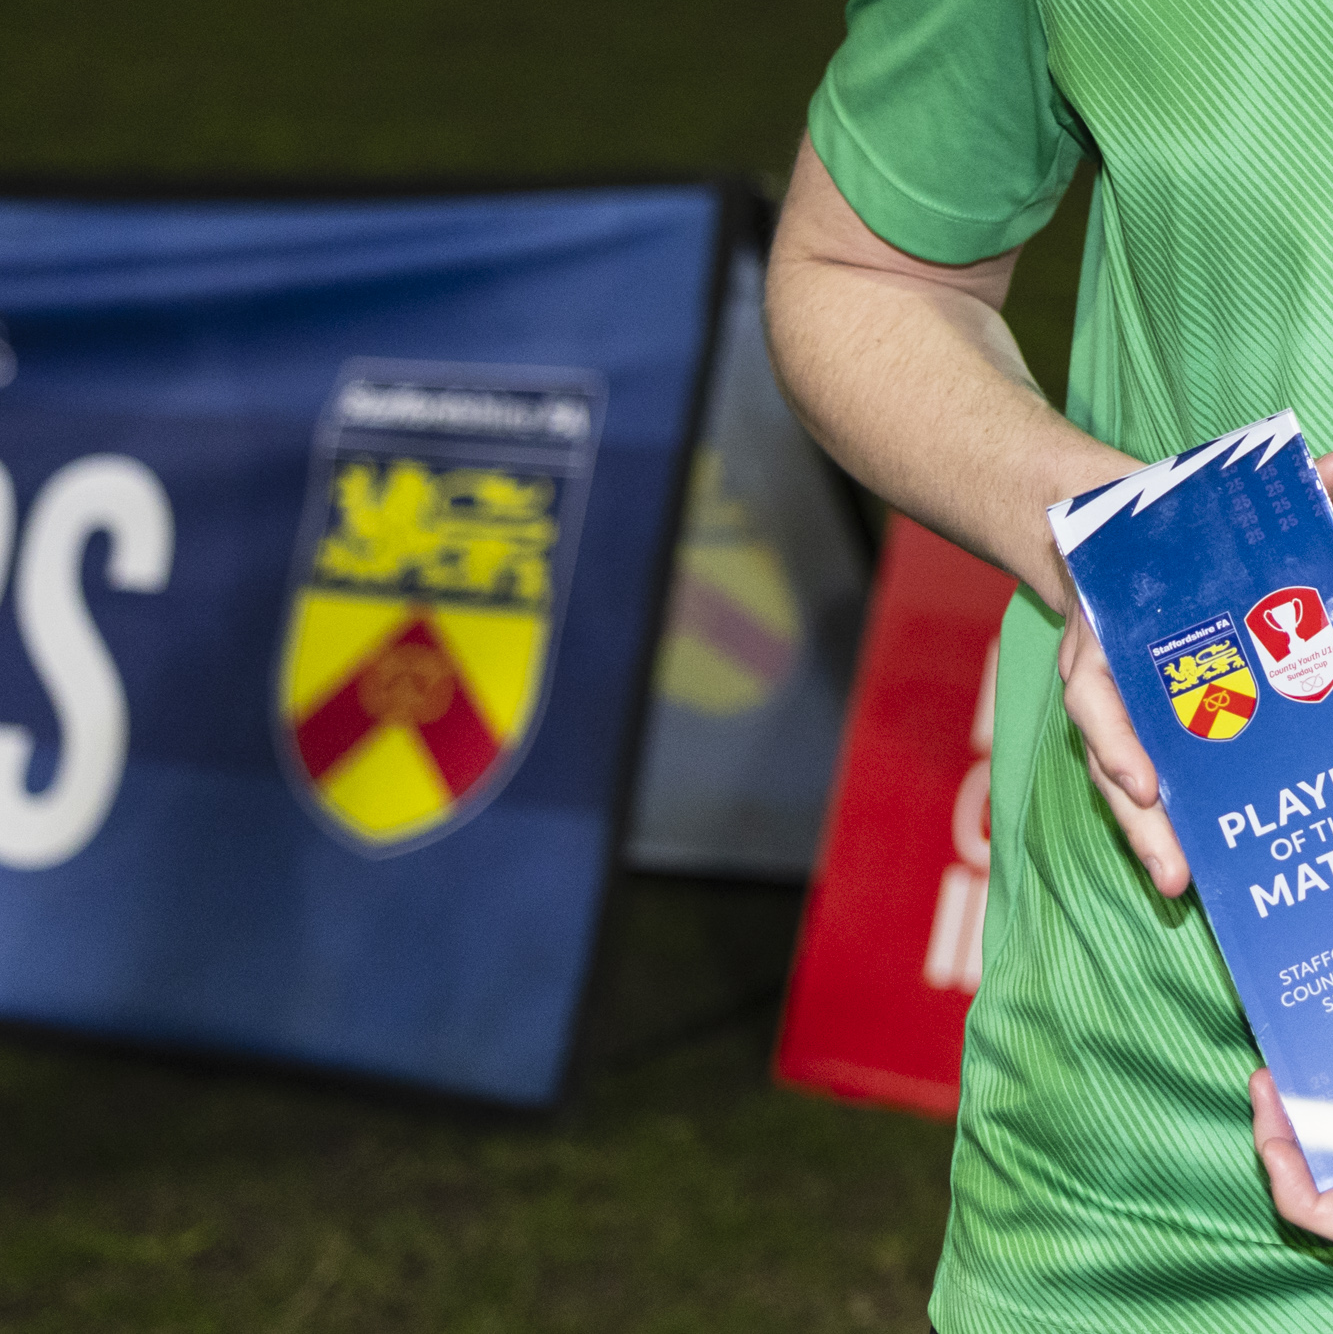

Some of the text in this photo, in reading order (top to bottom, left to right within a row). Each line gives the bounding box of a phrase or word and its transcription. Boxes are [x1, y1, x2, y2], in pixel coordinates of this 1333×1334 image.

[1152, 618, 1231, 657] Staffordshire FA
[0, 453, 177, 871] S
[1269, 662, 1298, 679] County
[1297, 651, 1321, 667] Youth
[1287, 660, 1328, 682] Sunday Cup
[1270, 829, 1306, 860] OF
